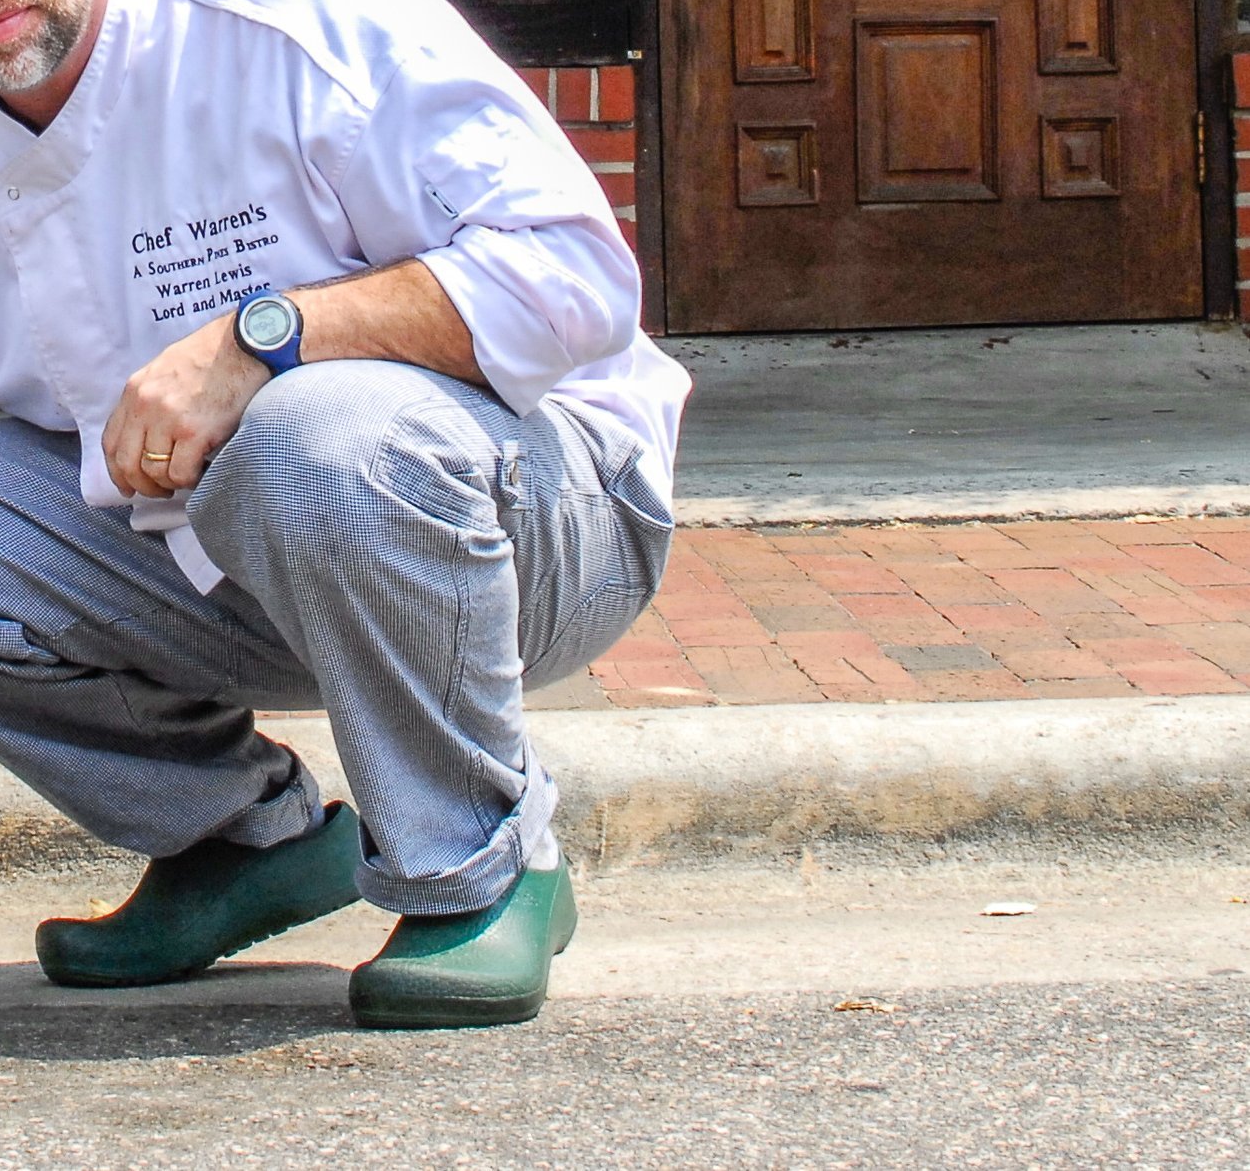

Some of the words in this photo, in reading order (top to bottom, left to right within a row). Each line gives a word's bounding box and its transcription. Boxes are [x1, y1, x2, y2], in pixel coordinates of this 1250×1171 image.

[132, 226, 173, 254] Chef
[187, 203, 268, 241] Warren's
[133, 265, 142, 279] A
[148, 257, 205, 276] SOUTHERN
[234, 234, 278, 253] BISTRO
[155, 277, 211, 299] Warren
[214, 263, 253, 285] Lewis
[151, 302, 185, 322] Lord
[192, 294, 216, 313] and
